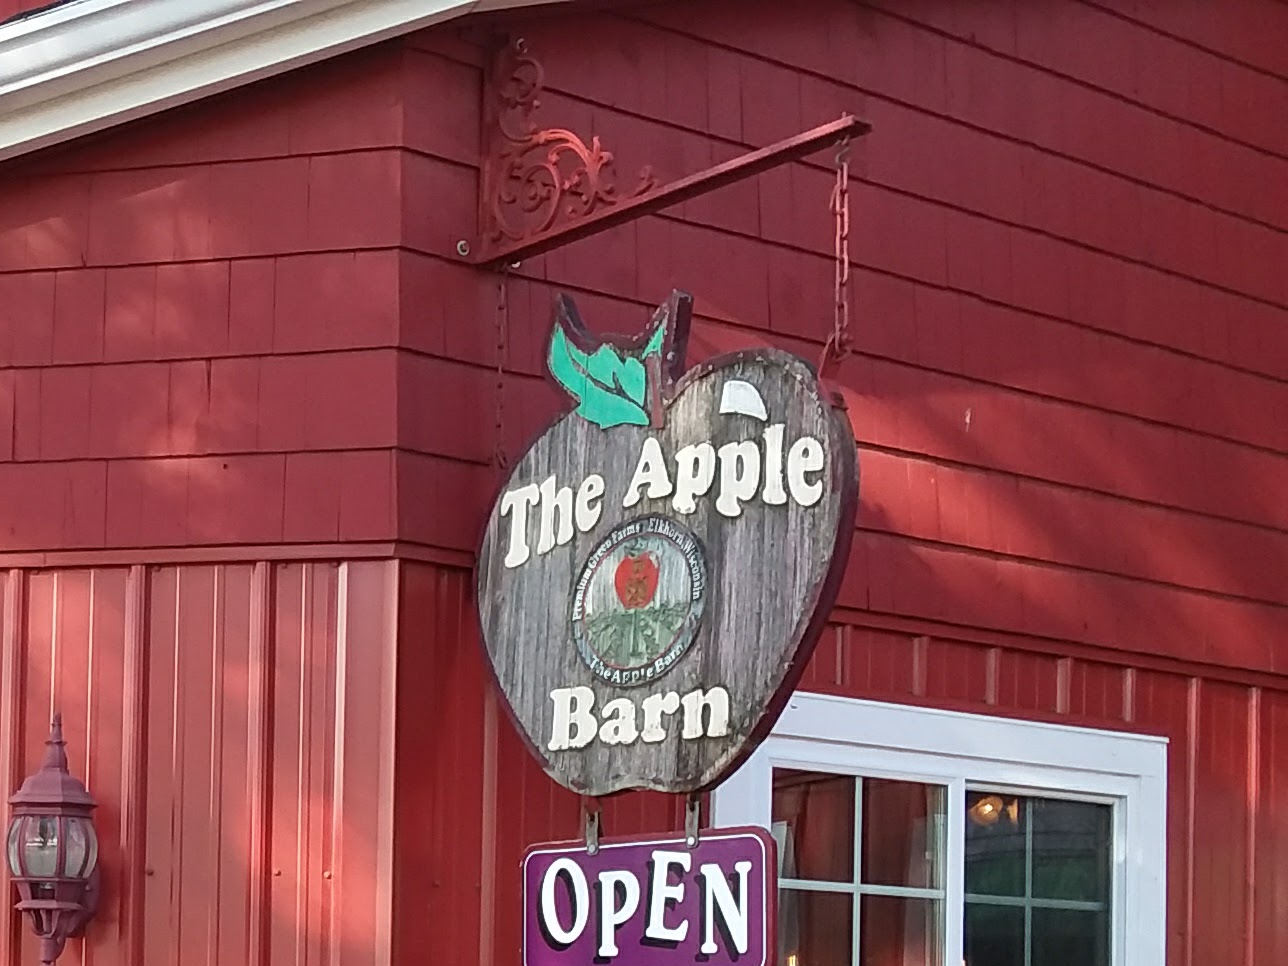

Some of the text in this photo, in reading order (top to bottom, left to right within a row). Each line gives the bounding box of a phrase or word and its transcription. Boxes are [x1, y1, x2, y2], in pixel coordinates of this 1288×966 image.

[500, 423, 826, 569] The Apple
[572, 522, 641, 622] Premium Green Farms
[590, 644, 685, 684] The Apple Barn
[548, 685, 730, 753] Barn
[540, 850, 753, 958] OPEN
